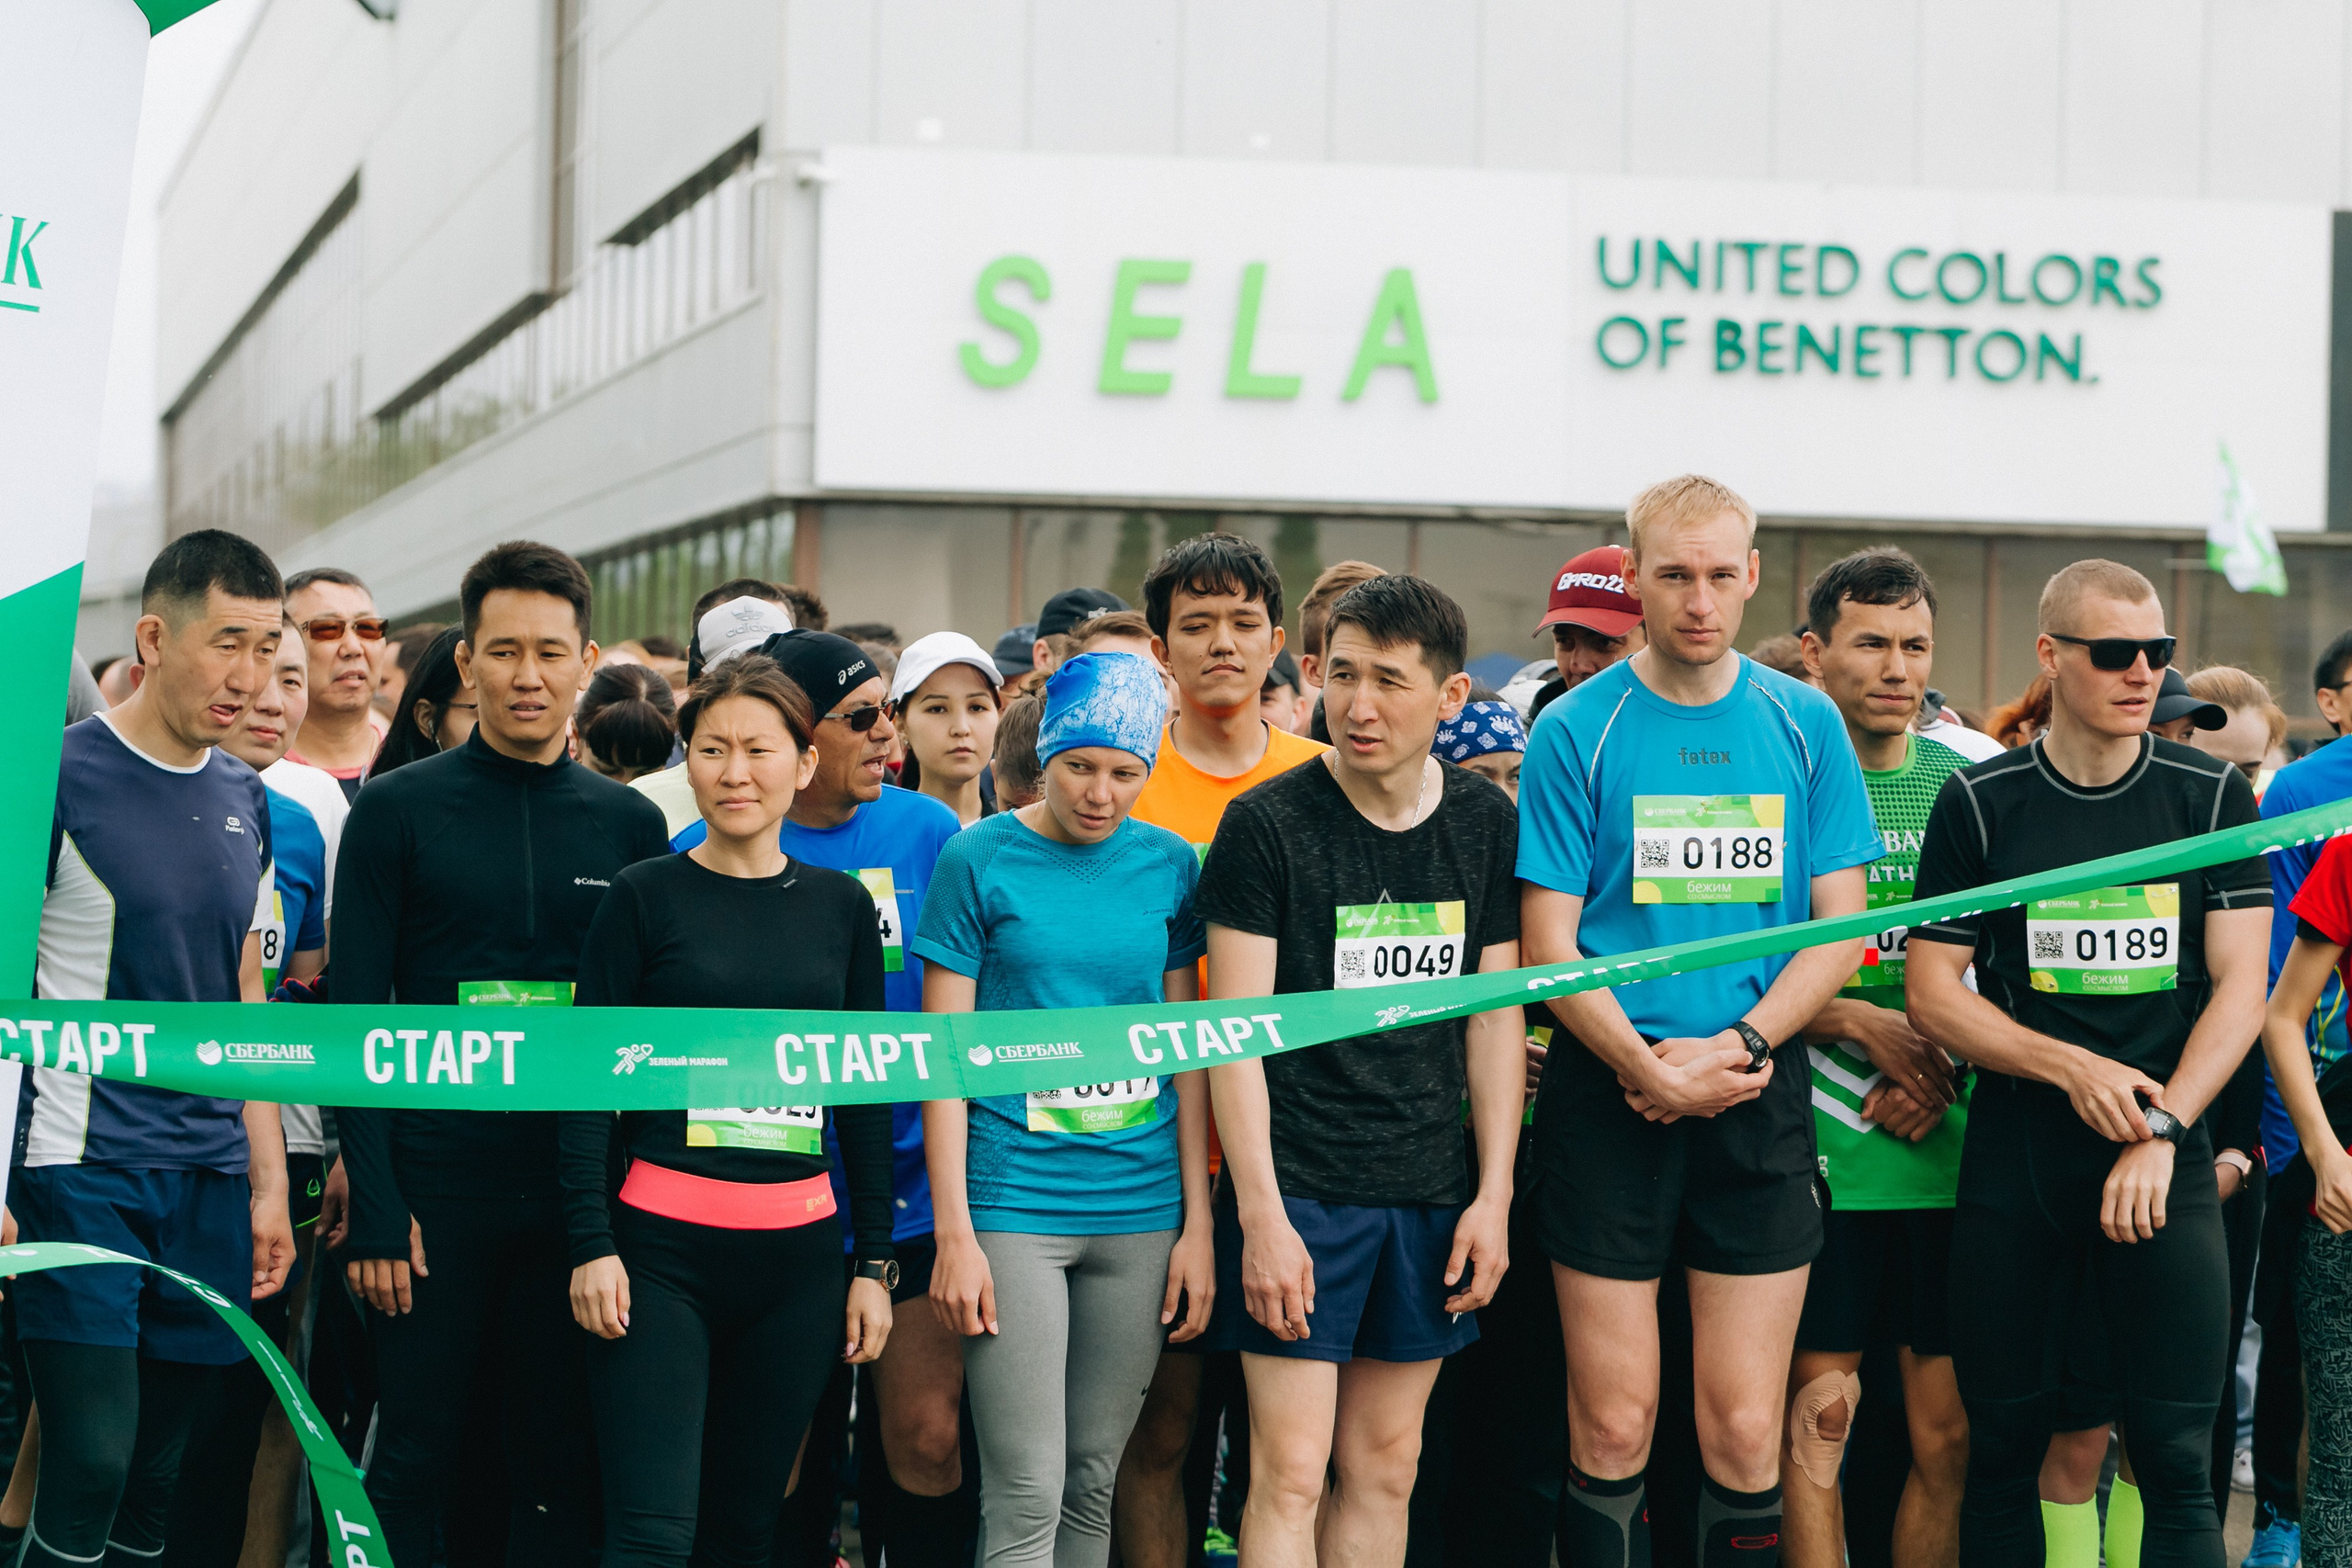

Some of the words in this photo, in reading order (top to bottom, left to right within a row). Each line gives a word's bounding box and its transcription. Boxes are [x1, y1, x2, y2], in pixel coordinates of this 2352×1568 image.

[1598, 237, 1860, 297] UNITED
[1886, 248, 2163, 309] COLORS
[958, 254, 1440, 403] SELA
[1598, 317, 1686, 369] OF
[847, 660, 865, 676] asics
[1683, 837, 1772, 869] 0188
[581, 877, 611, 887] Columbia
[1687, 880, 1732, 893] бежим
[263, 929, 278, 960] 8
[2075, 927, 2168, 962] 0189
[1374, 943, 1454, 978] 0049
[2082, 972, 2129, 985] бежим
[225, 1043, 315, 1060] СБЕРБАНК
[995, 1042, 1084, 1059] СБЕРБАНК
[1128, 1013, 1284, 1065] СТАРТ
[363, 1028, 525, 1085] СТАРТ
[648, 1055, 687, 1066] ЗЕЛЕНЫЙ
[689, 1057, 729, 1066] МАРАФОН
[775, 1032, 933, 1085] СТАРТ
[1081, 1109, 1123, 1122] бежим
[743, 1124, 787, 1141] бежим
[806, 1193, 827, 1212] EXR
